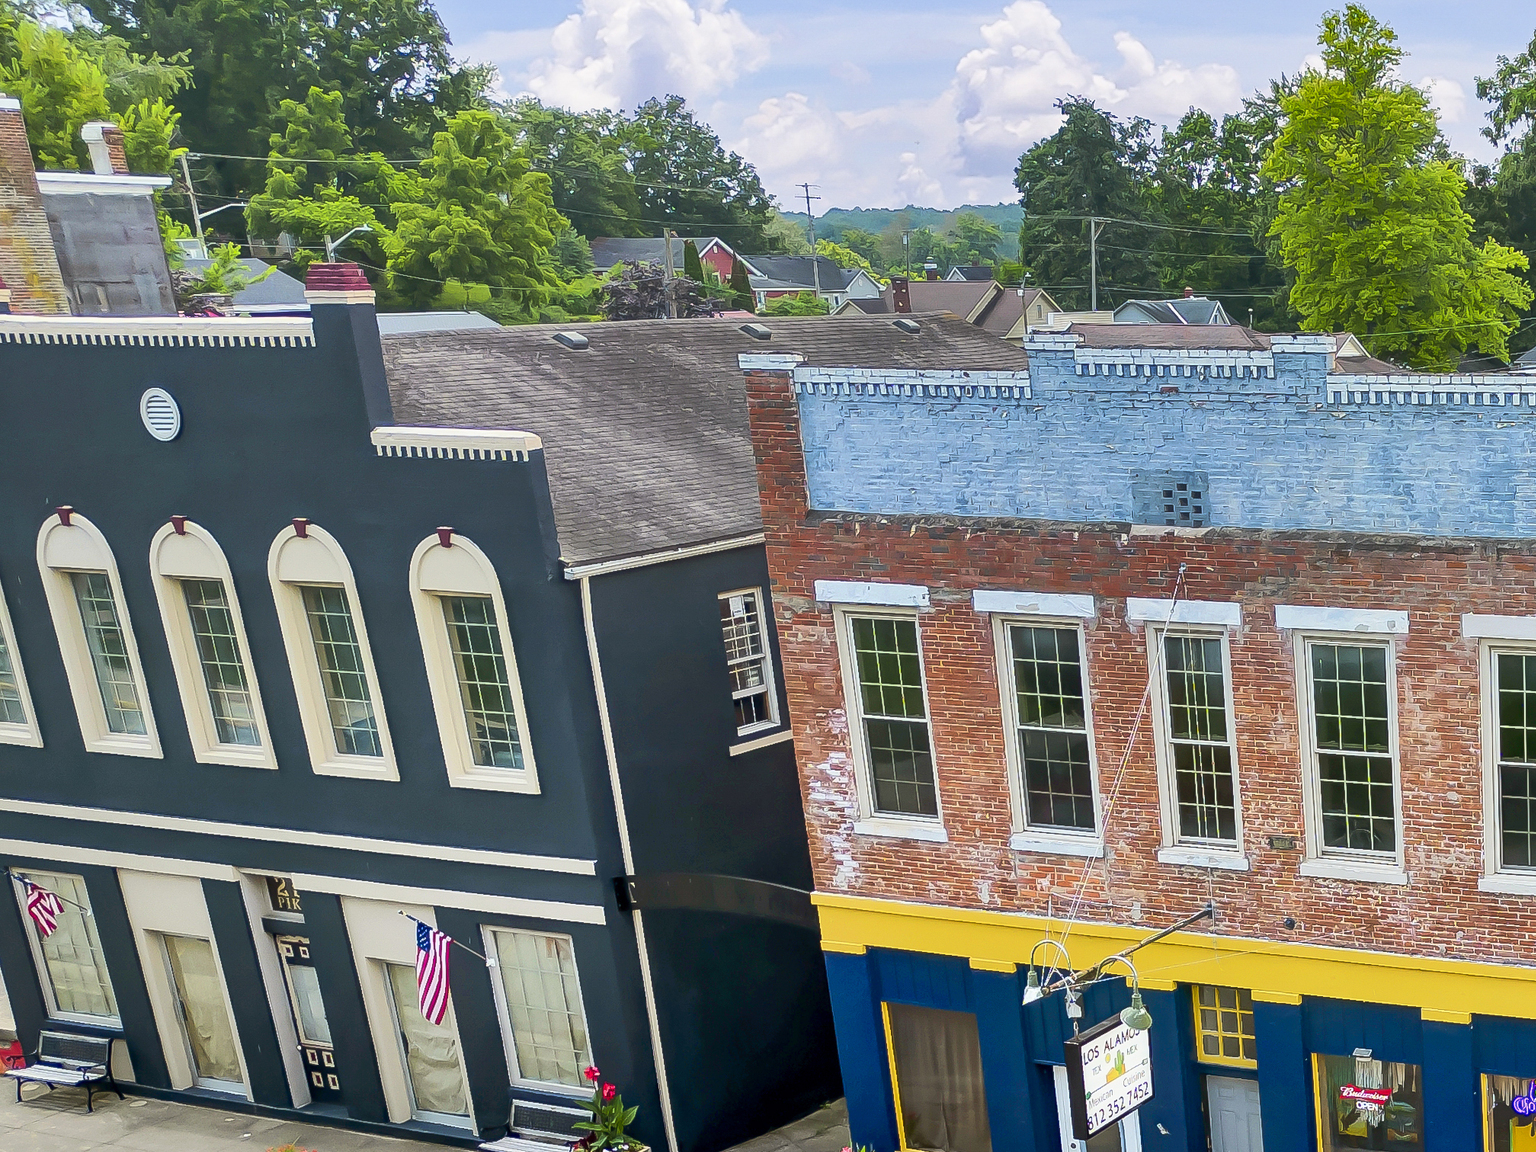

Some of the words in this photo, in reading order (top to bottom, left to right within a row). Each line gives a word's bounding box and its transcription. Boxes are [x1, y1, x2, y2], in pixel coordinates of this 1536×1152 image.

[1084, 1046, 1099, 1065] LOS
[1089, 1090, 1114, 1110] Mexican
[1122, 1070, 1146, 1087] Cuisine
[1340, 1087, 1388, 1101] Budweiser
[1088, 1108, 1106, 1130] 812
[1108, 1096, 1125, 1118] 352
[1127, 1082, 1149, 1105] 7452
[1356, 1101, 1378, 1111] OPEN
